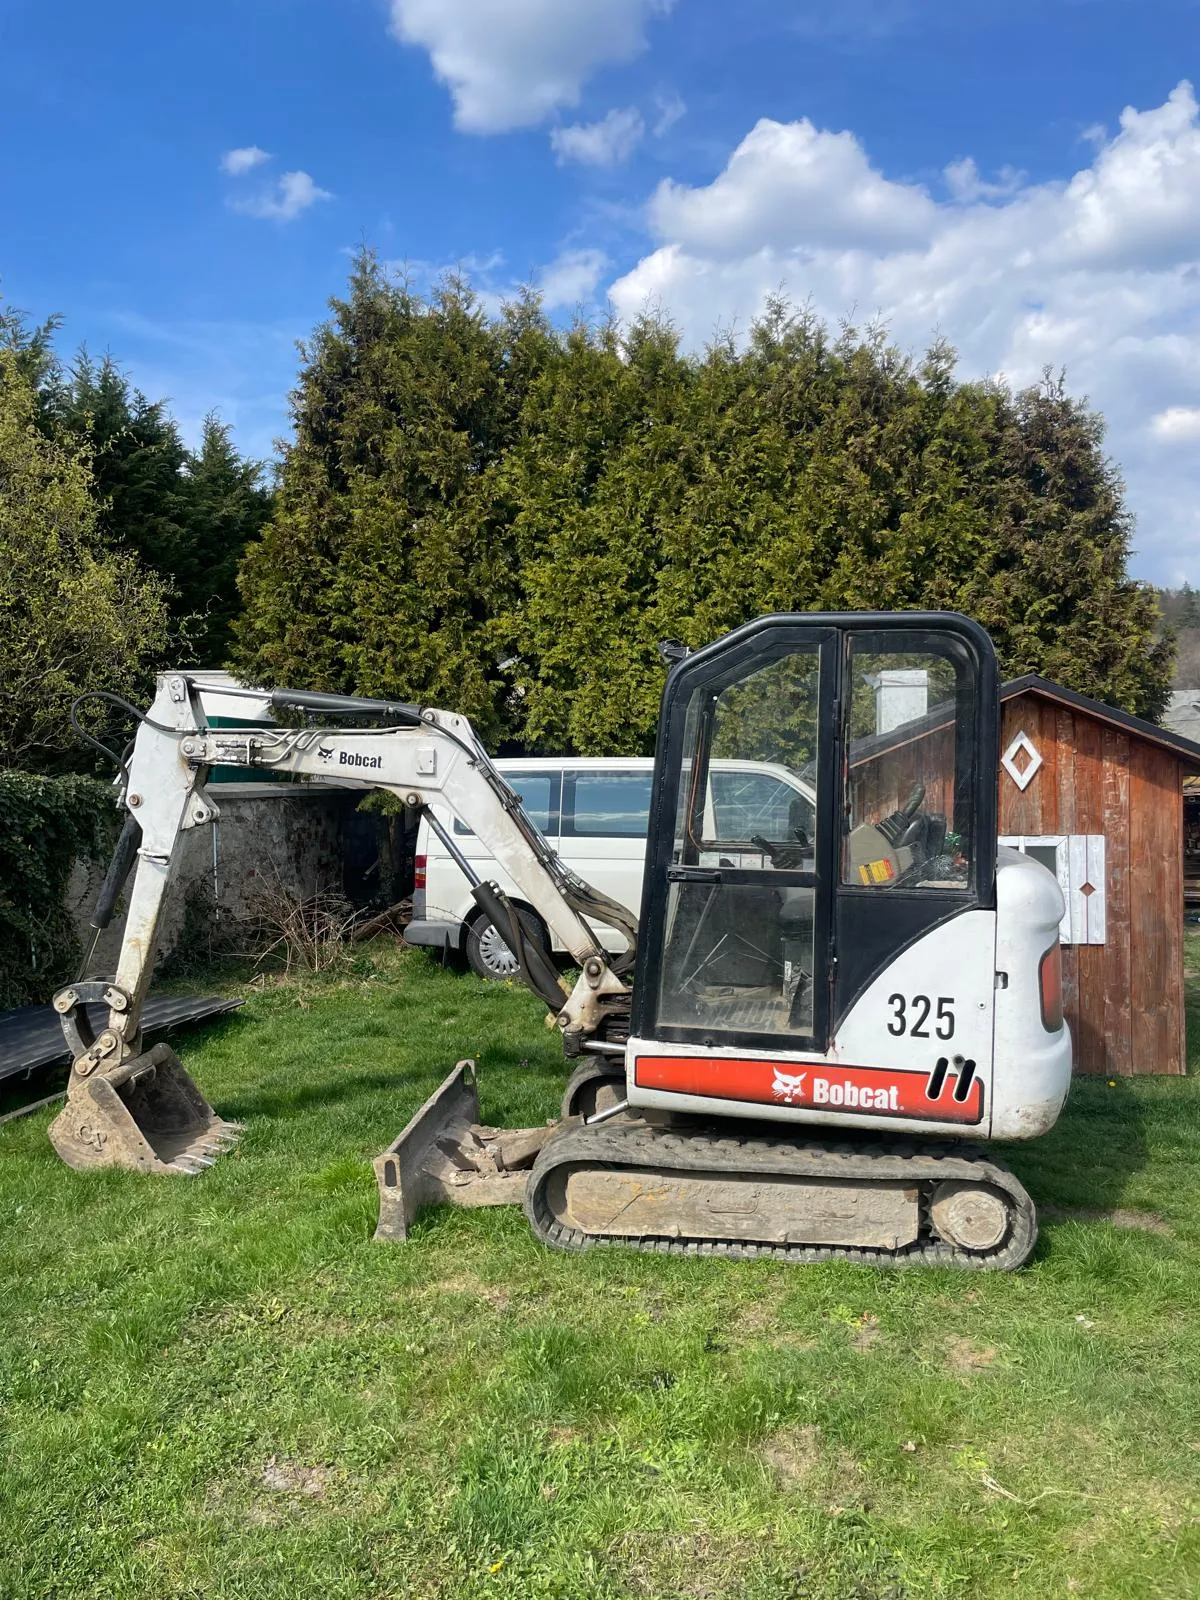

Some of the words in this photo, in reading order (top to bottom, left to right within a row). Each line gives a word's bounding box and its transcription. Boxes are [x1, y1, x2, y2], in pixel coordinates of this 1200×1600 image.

[339, 751, 382, 768] Bobcat
[887, 993, 955, 1040] 325
[813, 1078, 899, 1110] Bobcat
